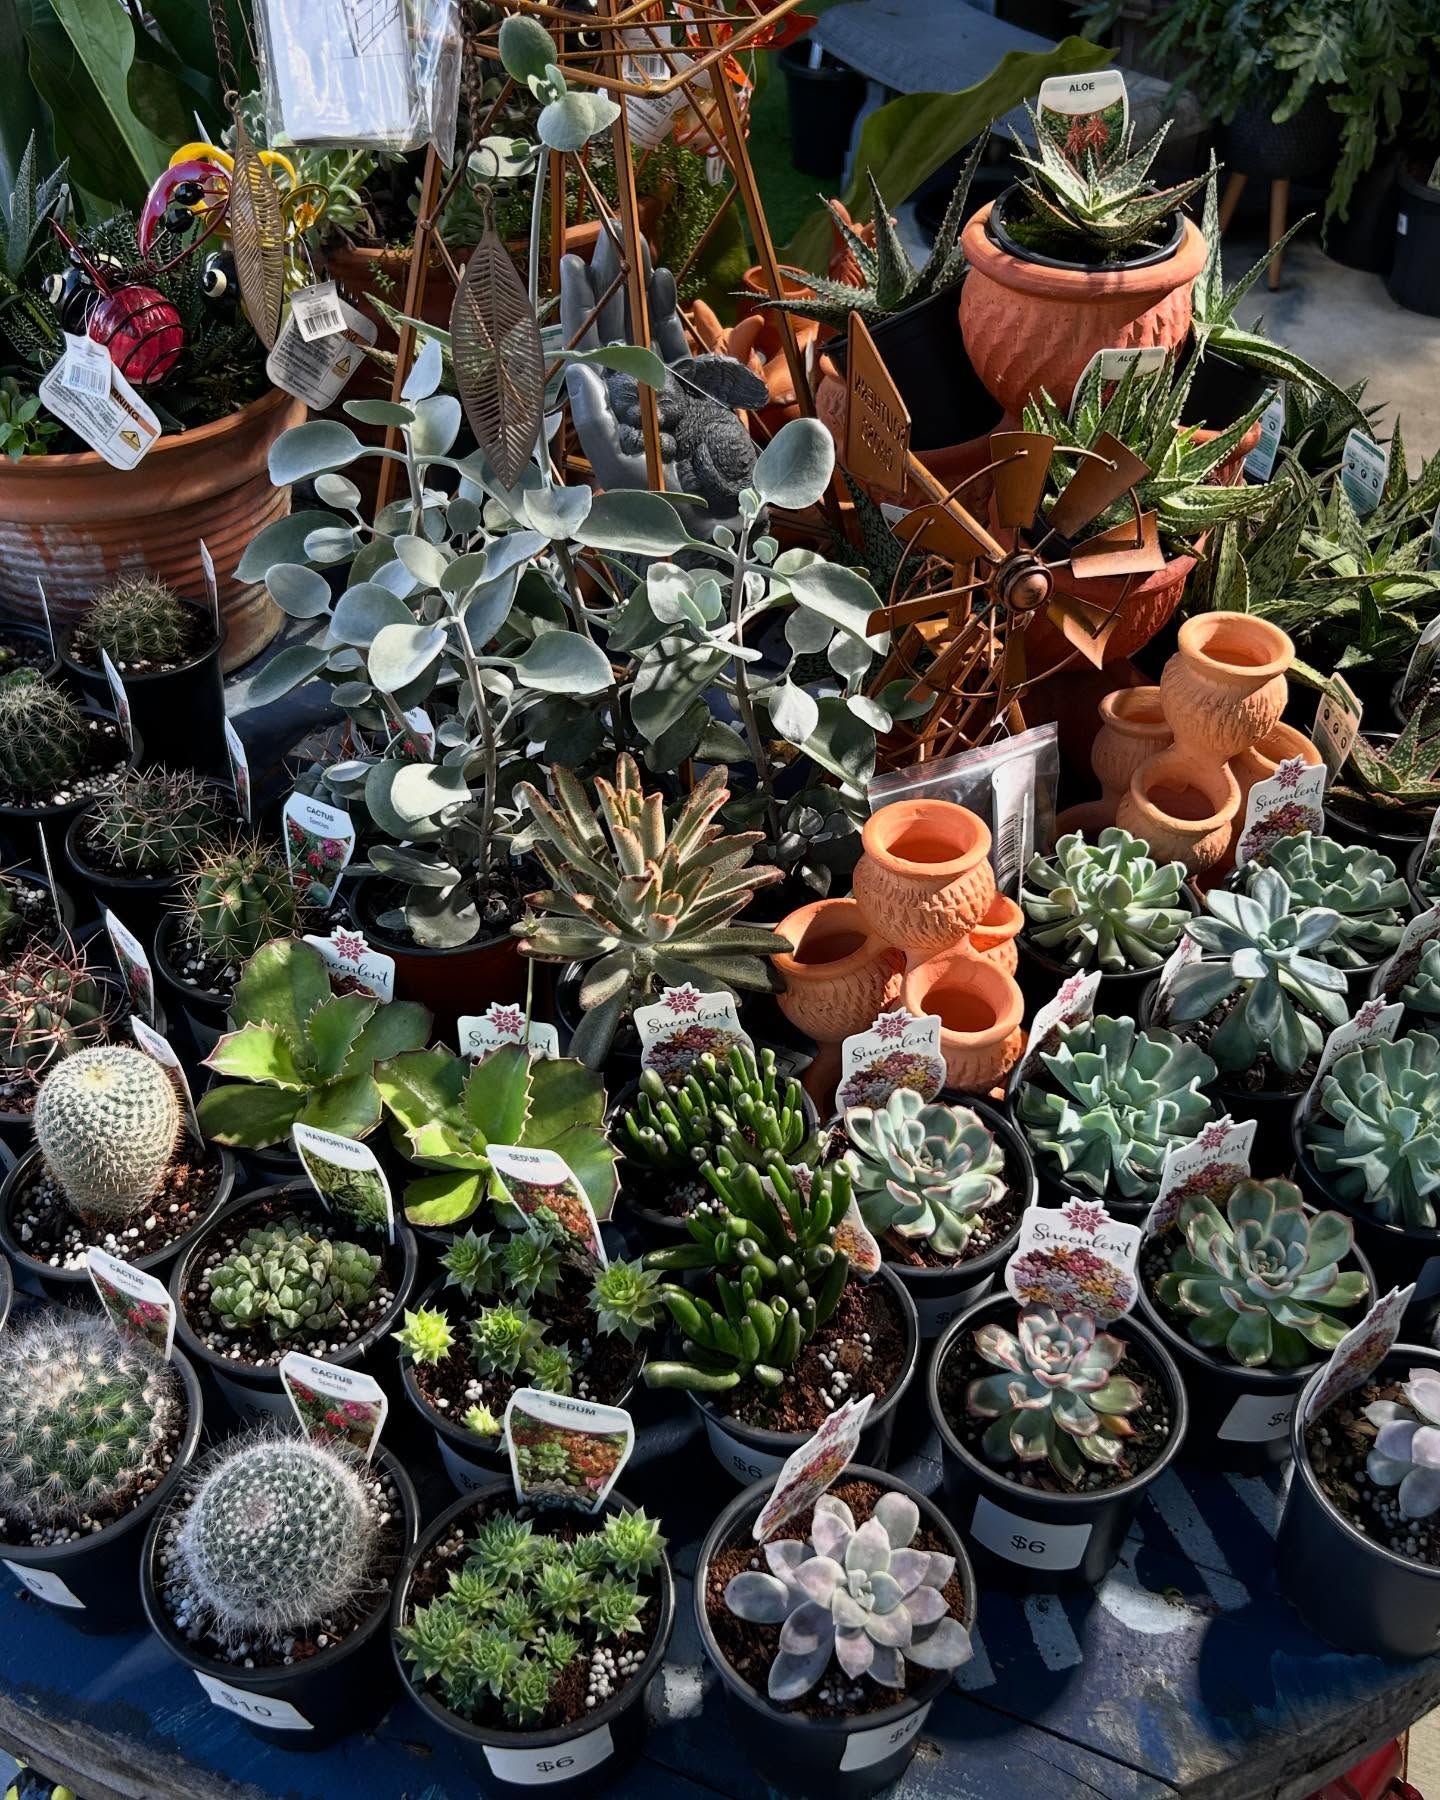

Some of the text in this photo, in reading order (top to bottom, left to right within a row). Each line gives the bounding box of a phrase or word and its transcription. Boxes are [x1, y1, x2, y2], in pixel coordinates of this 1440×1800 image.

[1068, 82, 1096, 93] ALOE
[1117, 354, 1136, 363] ALO
[111, 385, 141, 421] RNING
[1254, 779, 1321, 813] Succulent
[306, 806, 335, 822] CACTUS
[647, 1006, 733, 1034] Succulent
[851, 1029, 935, 1063] Succulent
[1329, 1019, 1395, 1058] Succulent
[303, 1131, 361, 1154] HAWORTHIA
[508, 1152, 541, 1164] SEDUM
[1171, 1135, 1248, 1180] Succulent
[1032, 1222, 1132, 1258] Succulent
[108, 1263, 145, 1286] CACTUS
[311, 1366, 353, 1386] CACTUS
[548, 1399, 597, 1416] SEDUM
[732, 1455, 763, 1479] $6
[1010, 1534, 1047, 1554] $6
[221, 1690, 273, 1718] $10
[536, 1755, 575, 1773] $6
